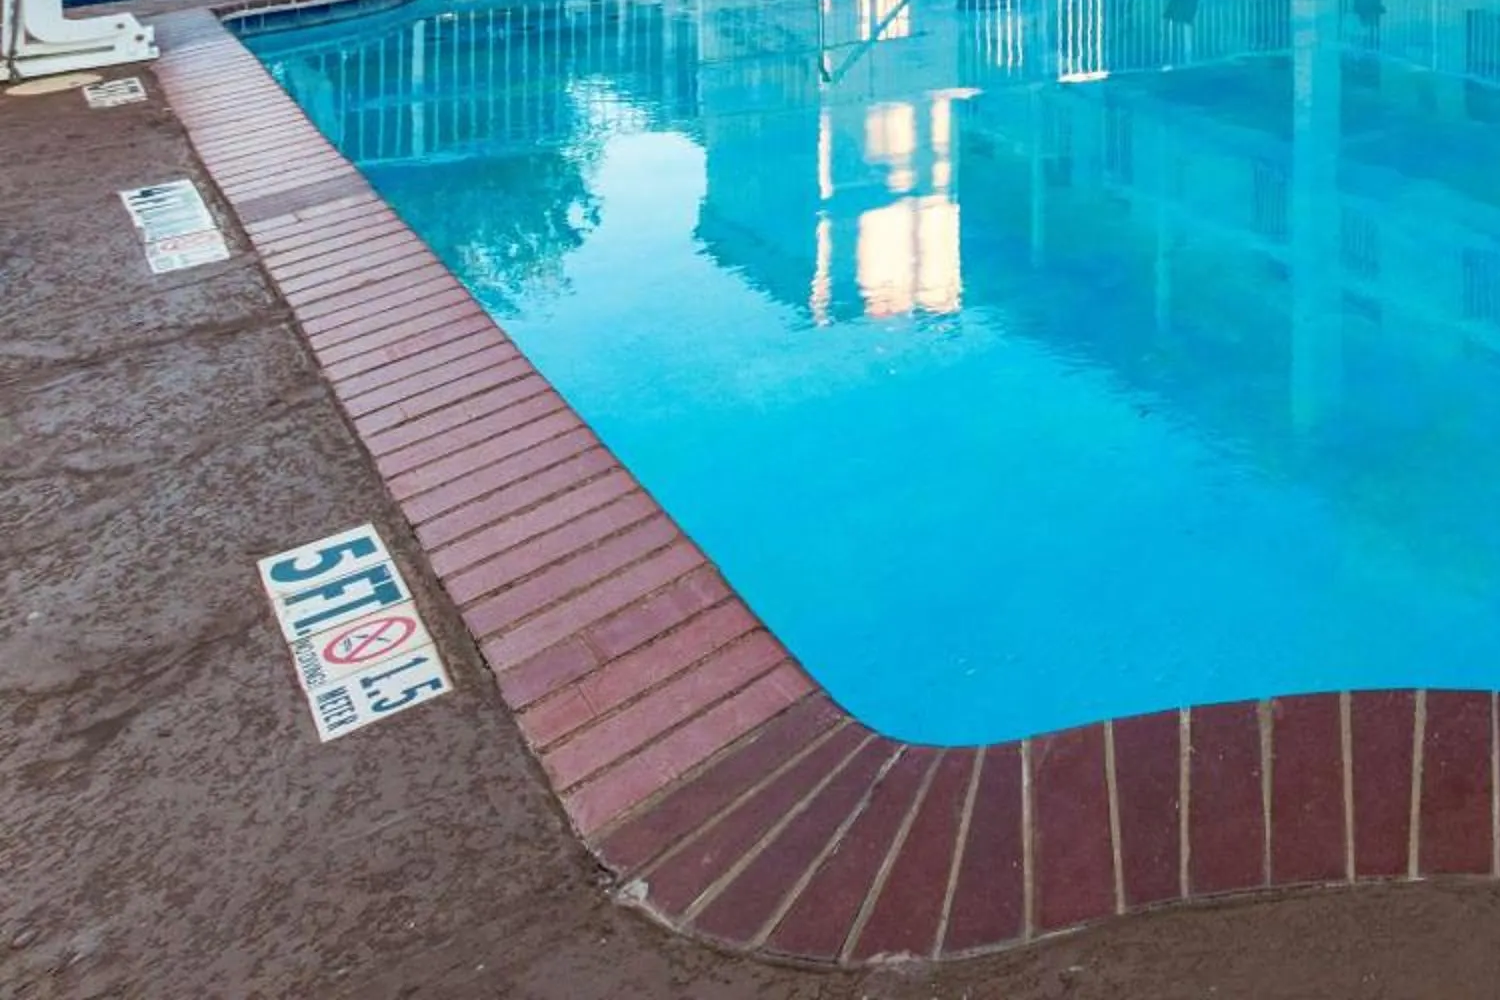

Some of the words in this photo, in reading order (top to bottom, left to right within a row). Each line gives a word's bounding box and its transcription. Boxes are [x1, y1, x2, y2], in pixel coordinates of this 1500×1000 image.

[270, 536, 378, 582] 5
[360, 656, 444, 713] 1.5
[316, 685, 359, 732] METER
